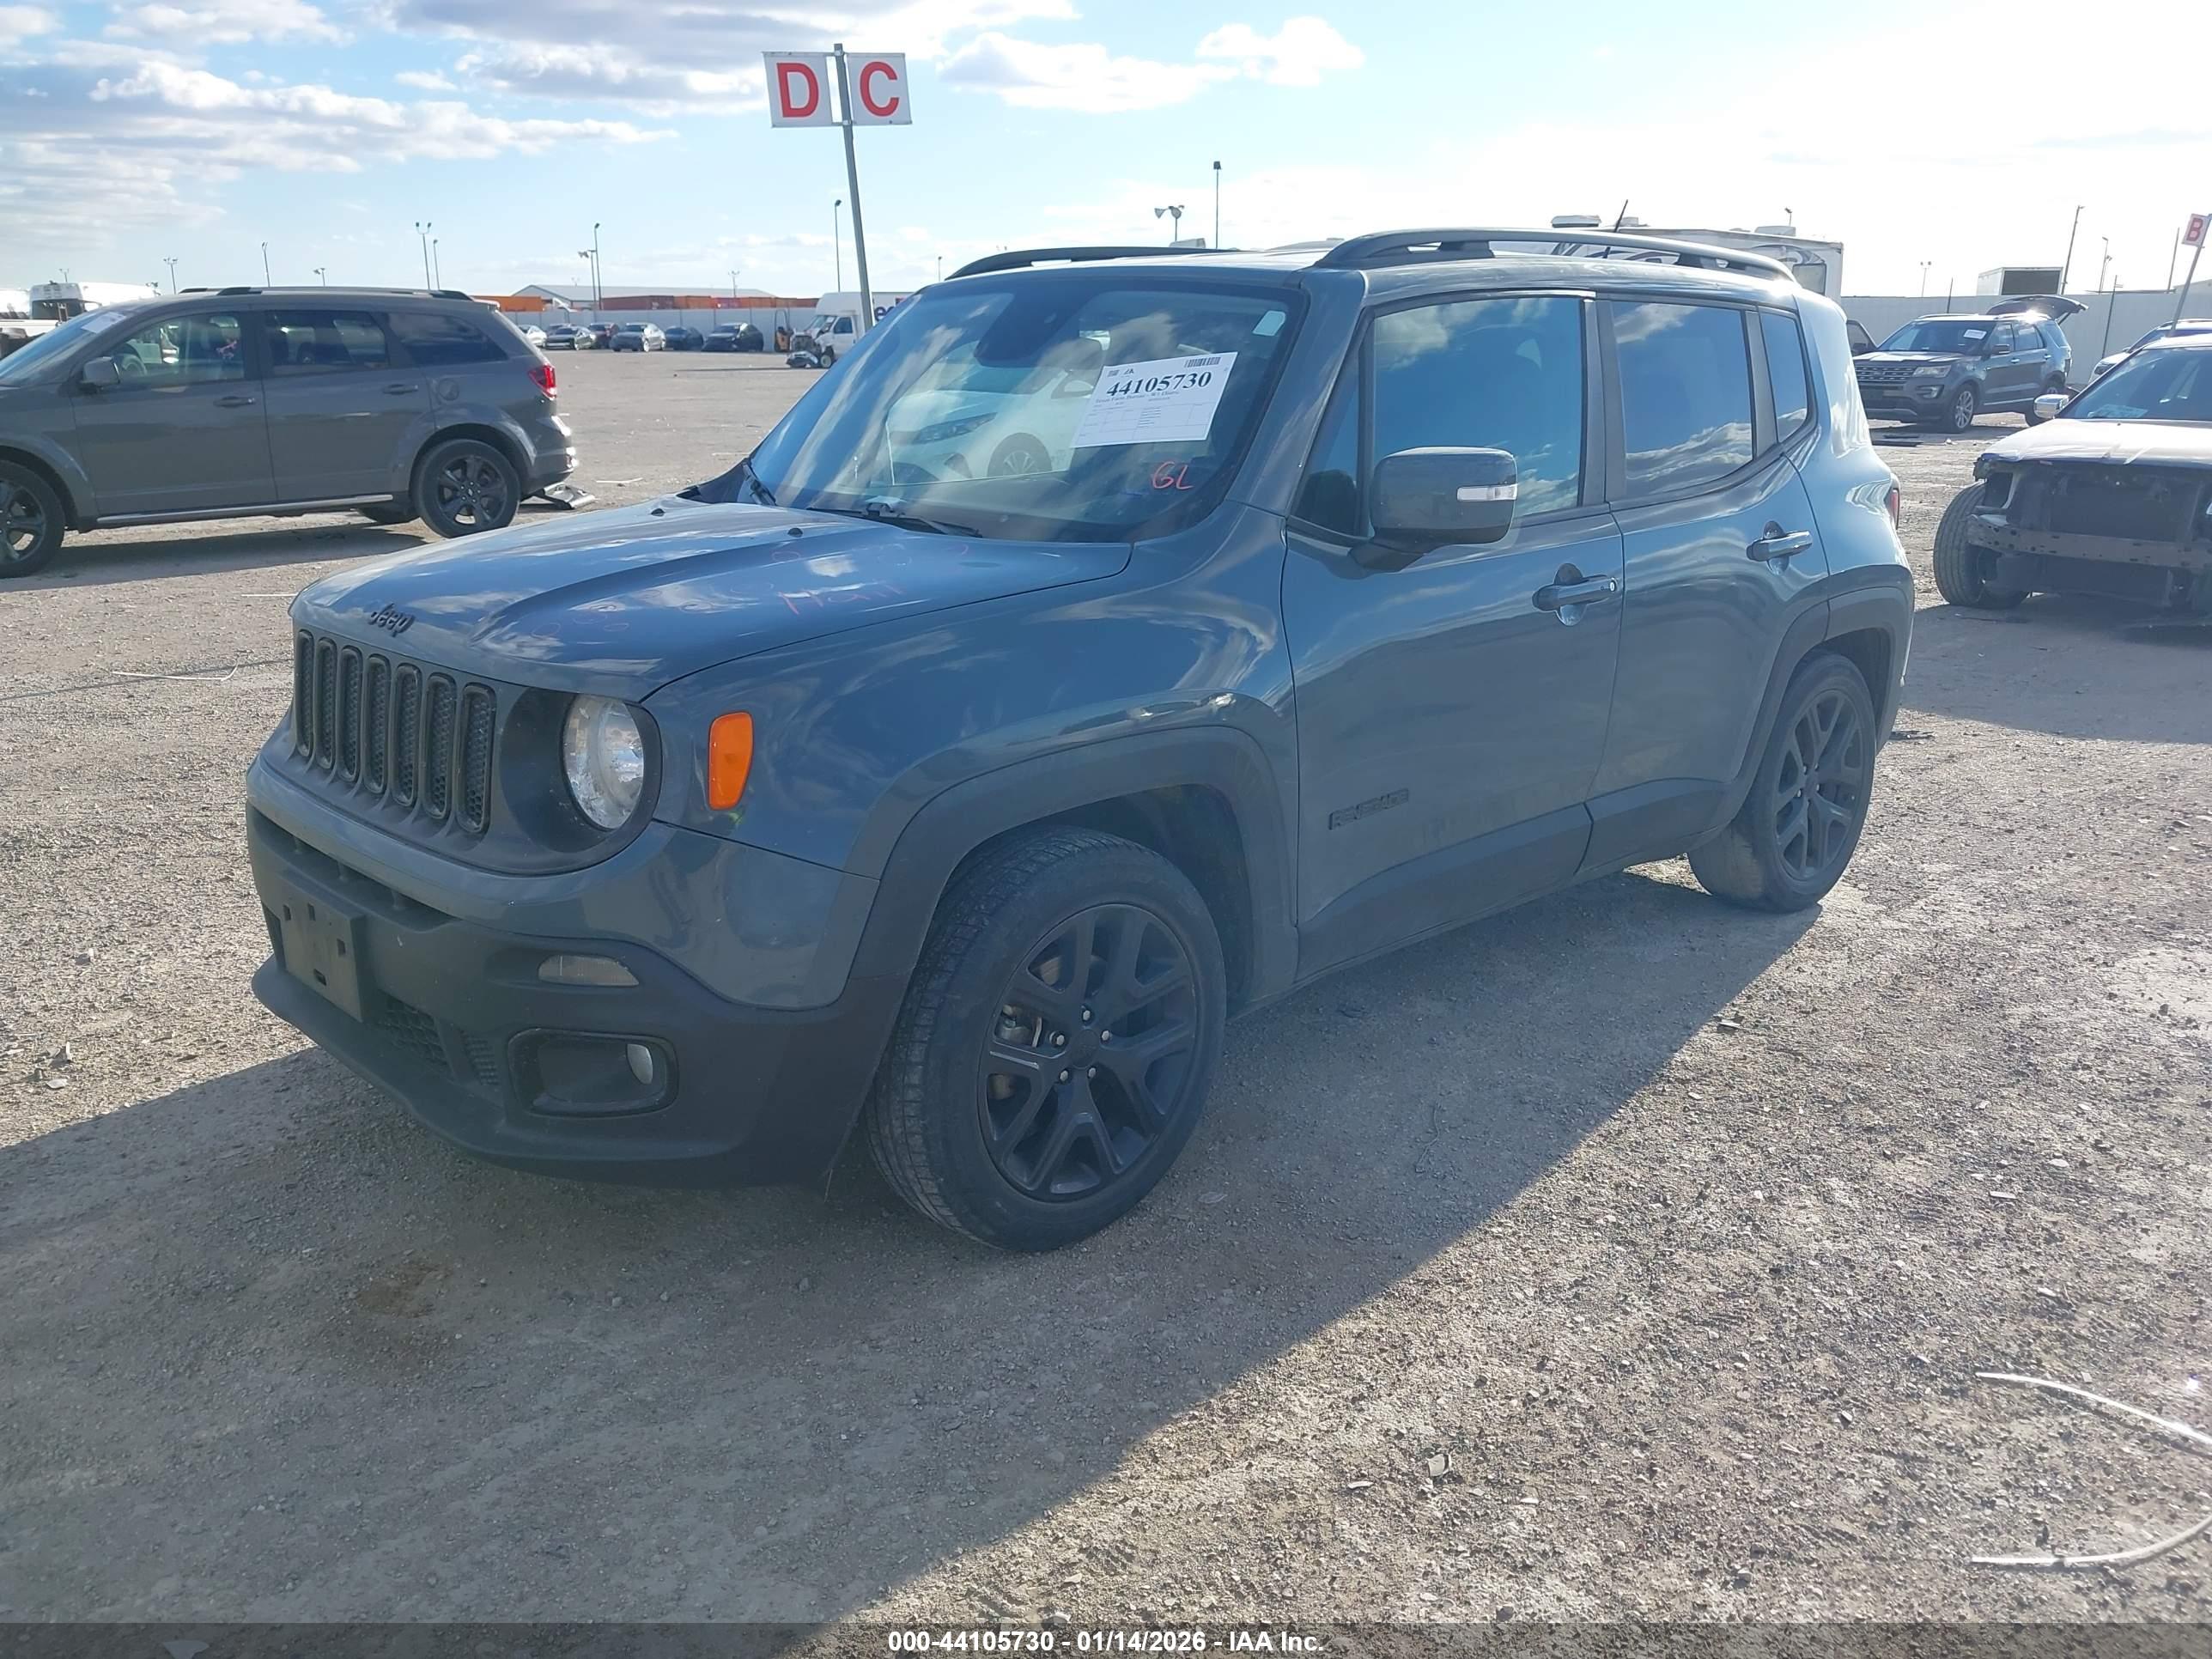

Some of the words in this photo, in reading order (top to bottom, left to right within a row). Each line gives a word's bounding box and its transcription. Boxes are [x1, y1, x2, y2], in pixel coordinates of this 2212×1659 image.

[776, 62, 819, 118] D
[860, 61, 900, 117] C
[2186, 217, 2203, 241] B
[1107, 372, 1212, 397] 44105730
[368, 603, 416, 638] Jeep
